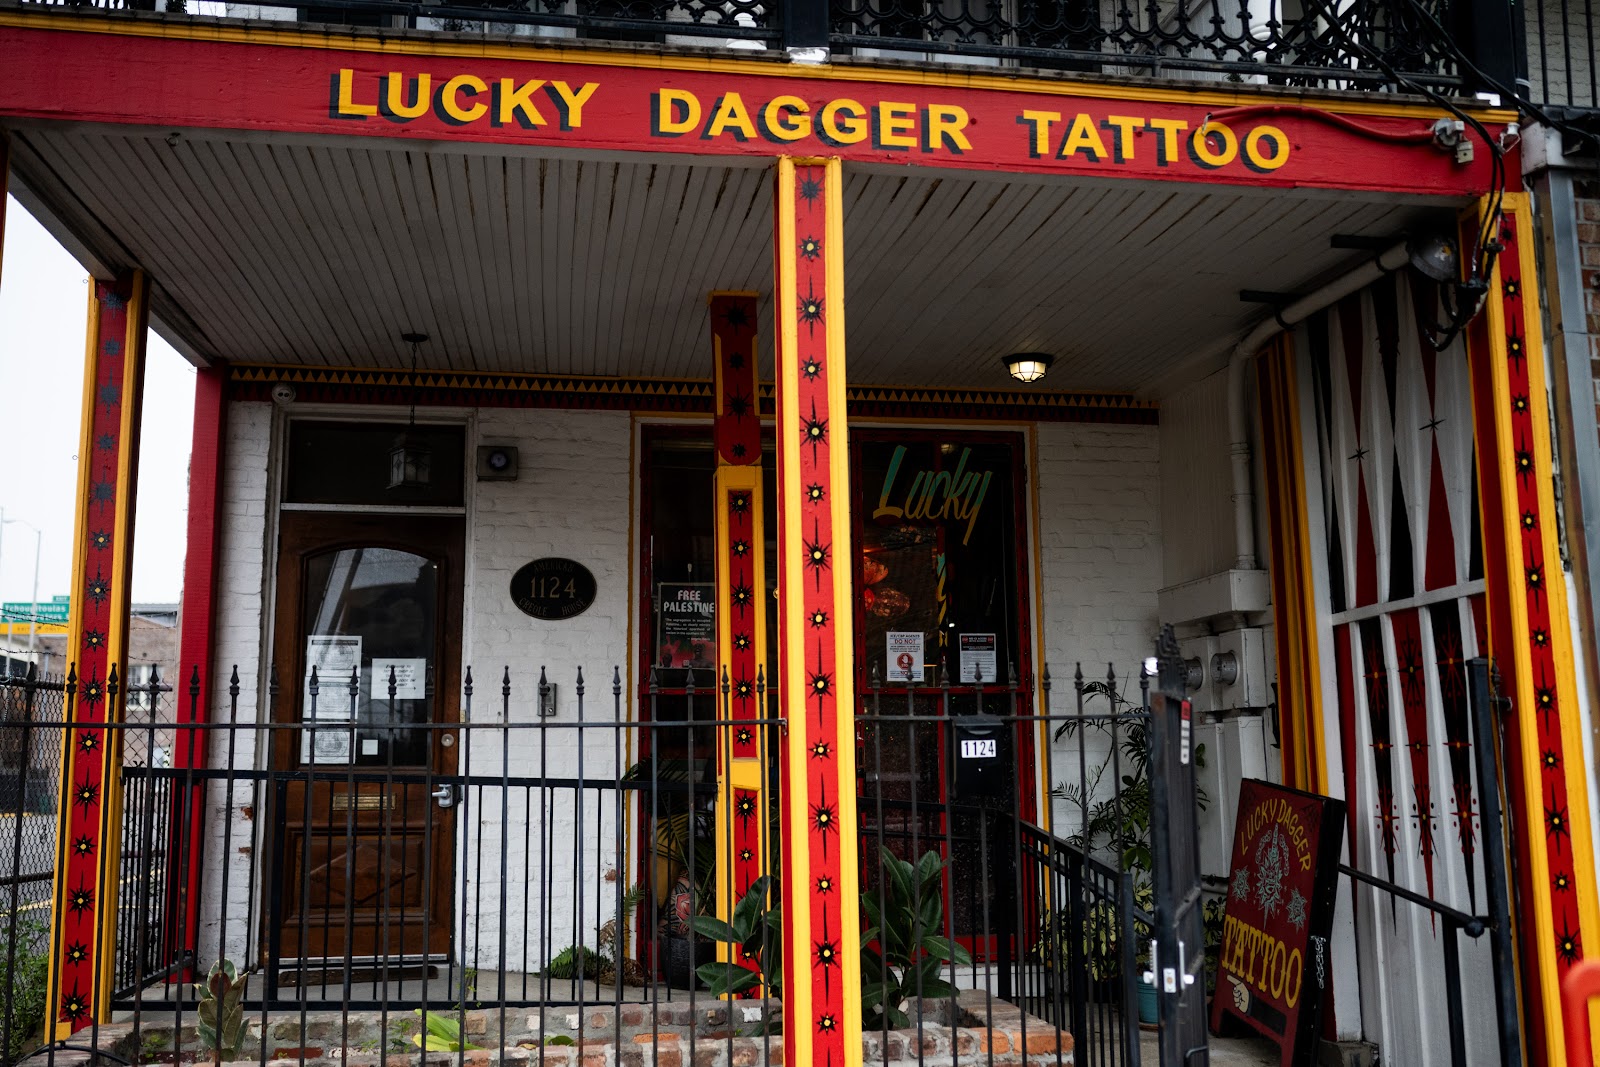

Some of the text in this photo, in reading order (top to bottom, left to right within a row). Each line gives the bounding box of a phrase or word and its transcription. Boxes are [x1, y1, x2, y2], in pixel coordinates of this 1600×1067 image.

[336, 68, 1290, 170] LUCKY DAGGER TATTOO
[873, 445, 993, 546] Lucky
[530, 576, 576, 599] 1124
[678, 590, 701, 601] FREE
[5, 604, 66, 614] Tchouitoulas
[519, 597, 548, 616] CREOLE
[561, 599, 587, 616] HOUSE
[663, 601, 715, 612] PALESTINE
[964, 741, 994, 756] 1124
[1241, 798, 1311, 872] LUCKY DAGGER
[1222, 914, 1302, 1009] TATTOO
